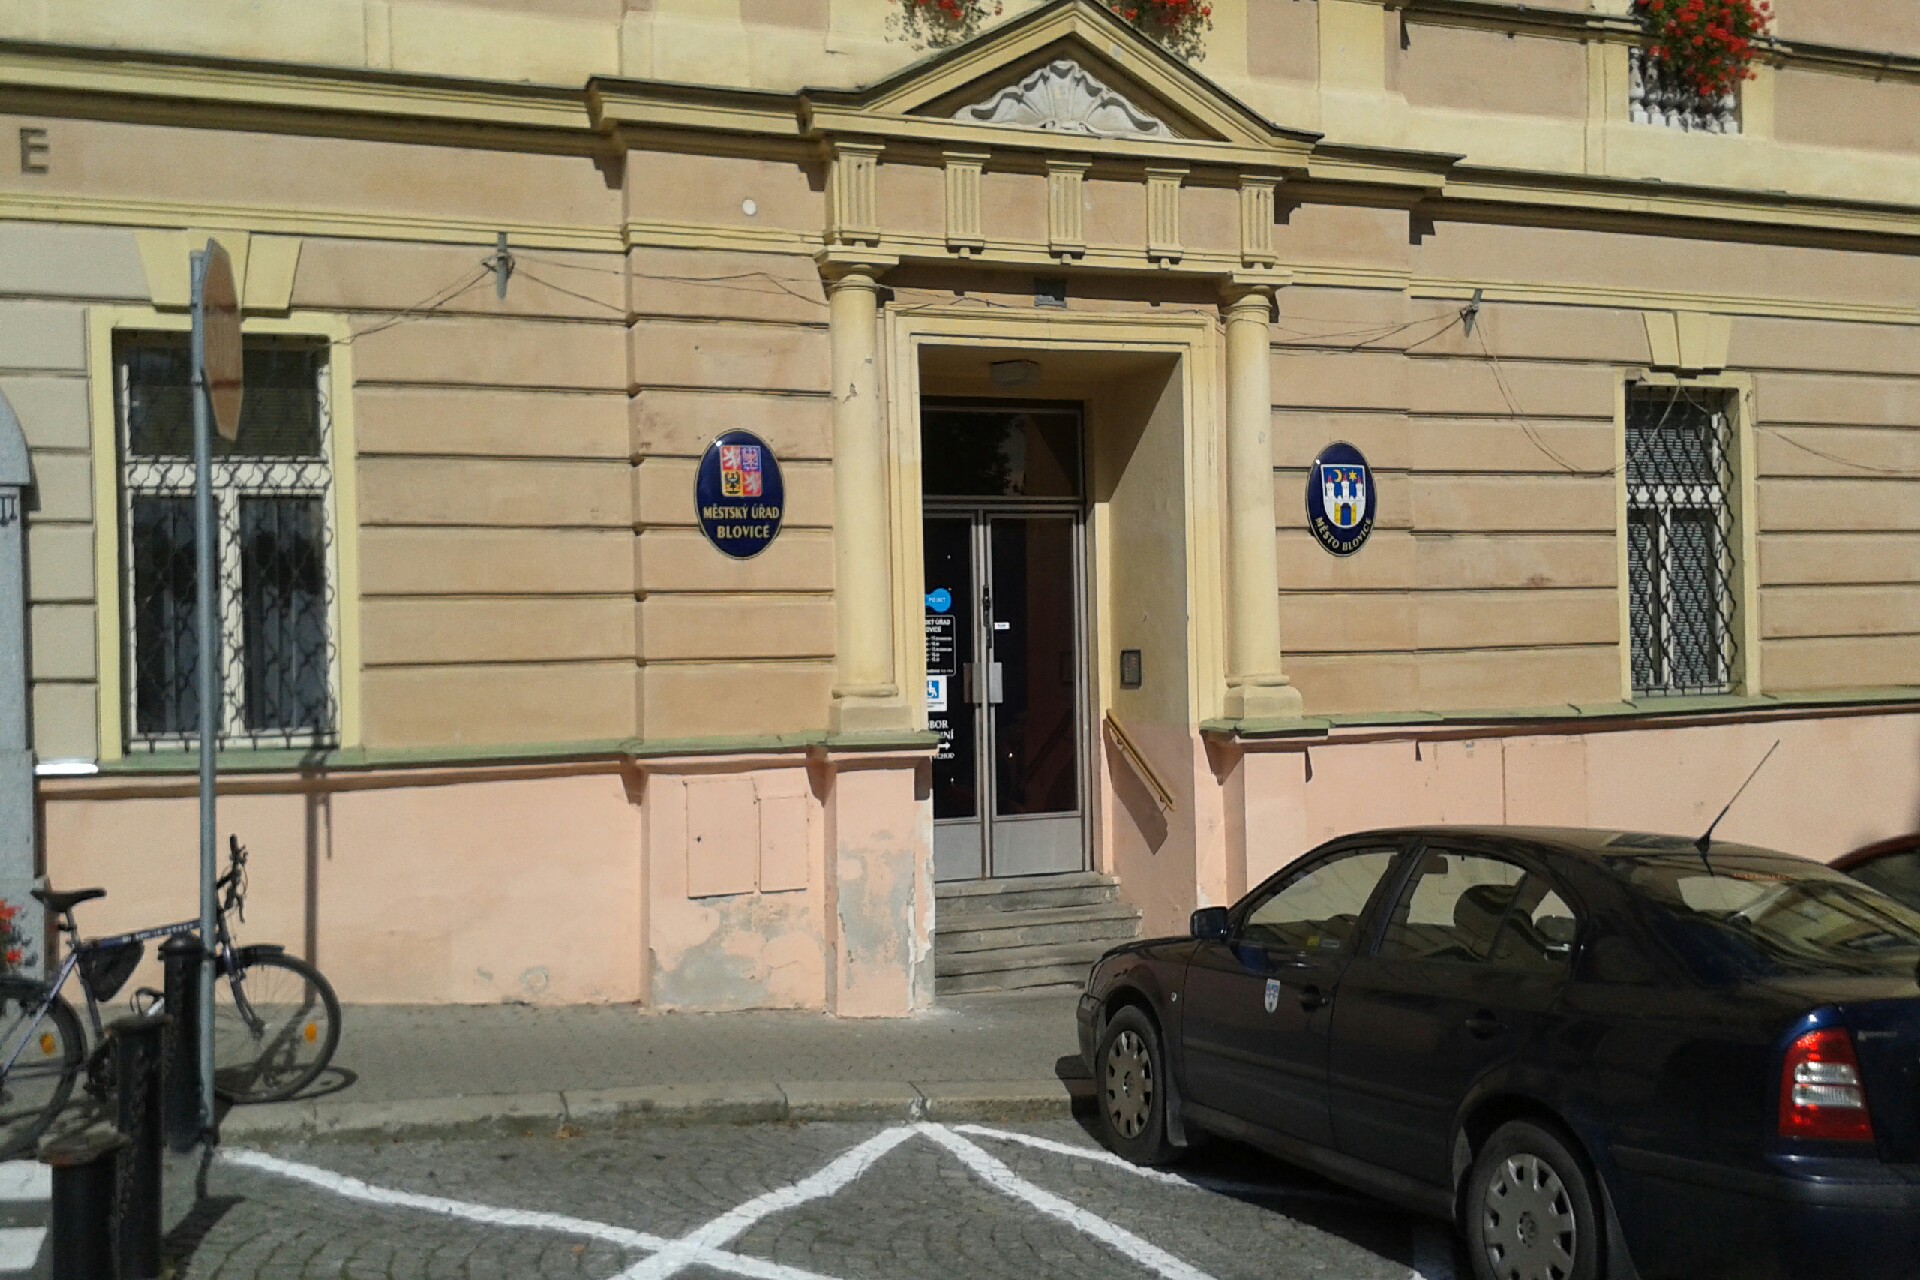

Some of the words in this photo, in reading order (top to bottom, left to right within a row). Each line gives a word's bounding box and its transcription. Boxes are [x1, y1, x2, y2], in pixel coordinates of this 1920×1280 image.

[703, 503, 748, 519] MĚSTSKÝ
[751, 503, 780, 519] ÚŘAD
[716, 524, 770, 539] BLOVICE
[1315, 516, 1340, 549] MĚSTO
[1342, 517, 1372, 551] BLOVICE
[928, 719, 949, 730] BOR
